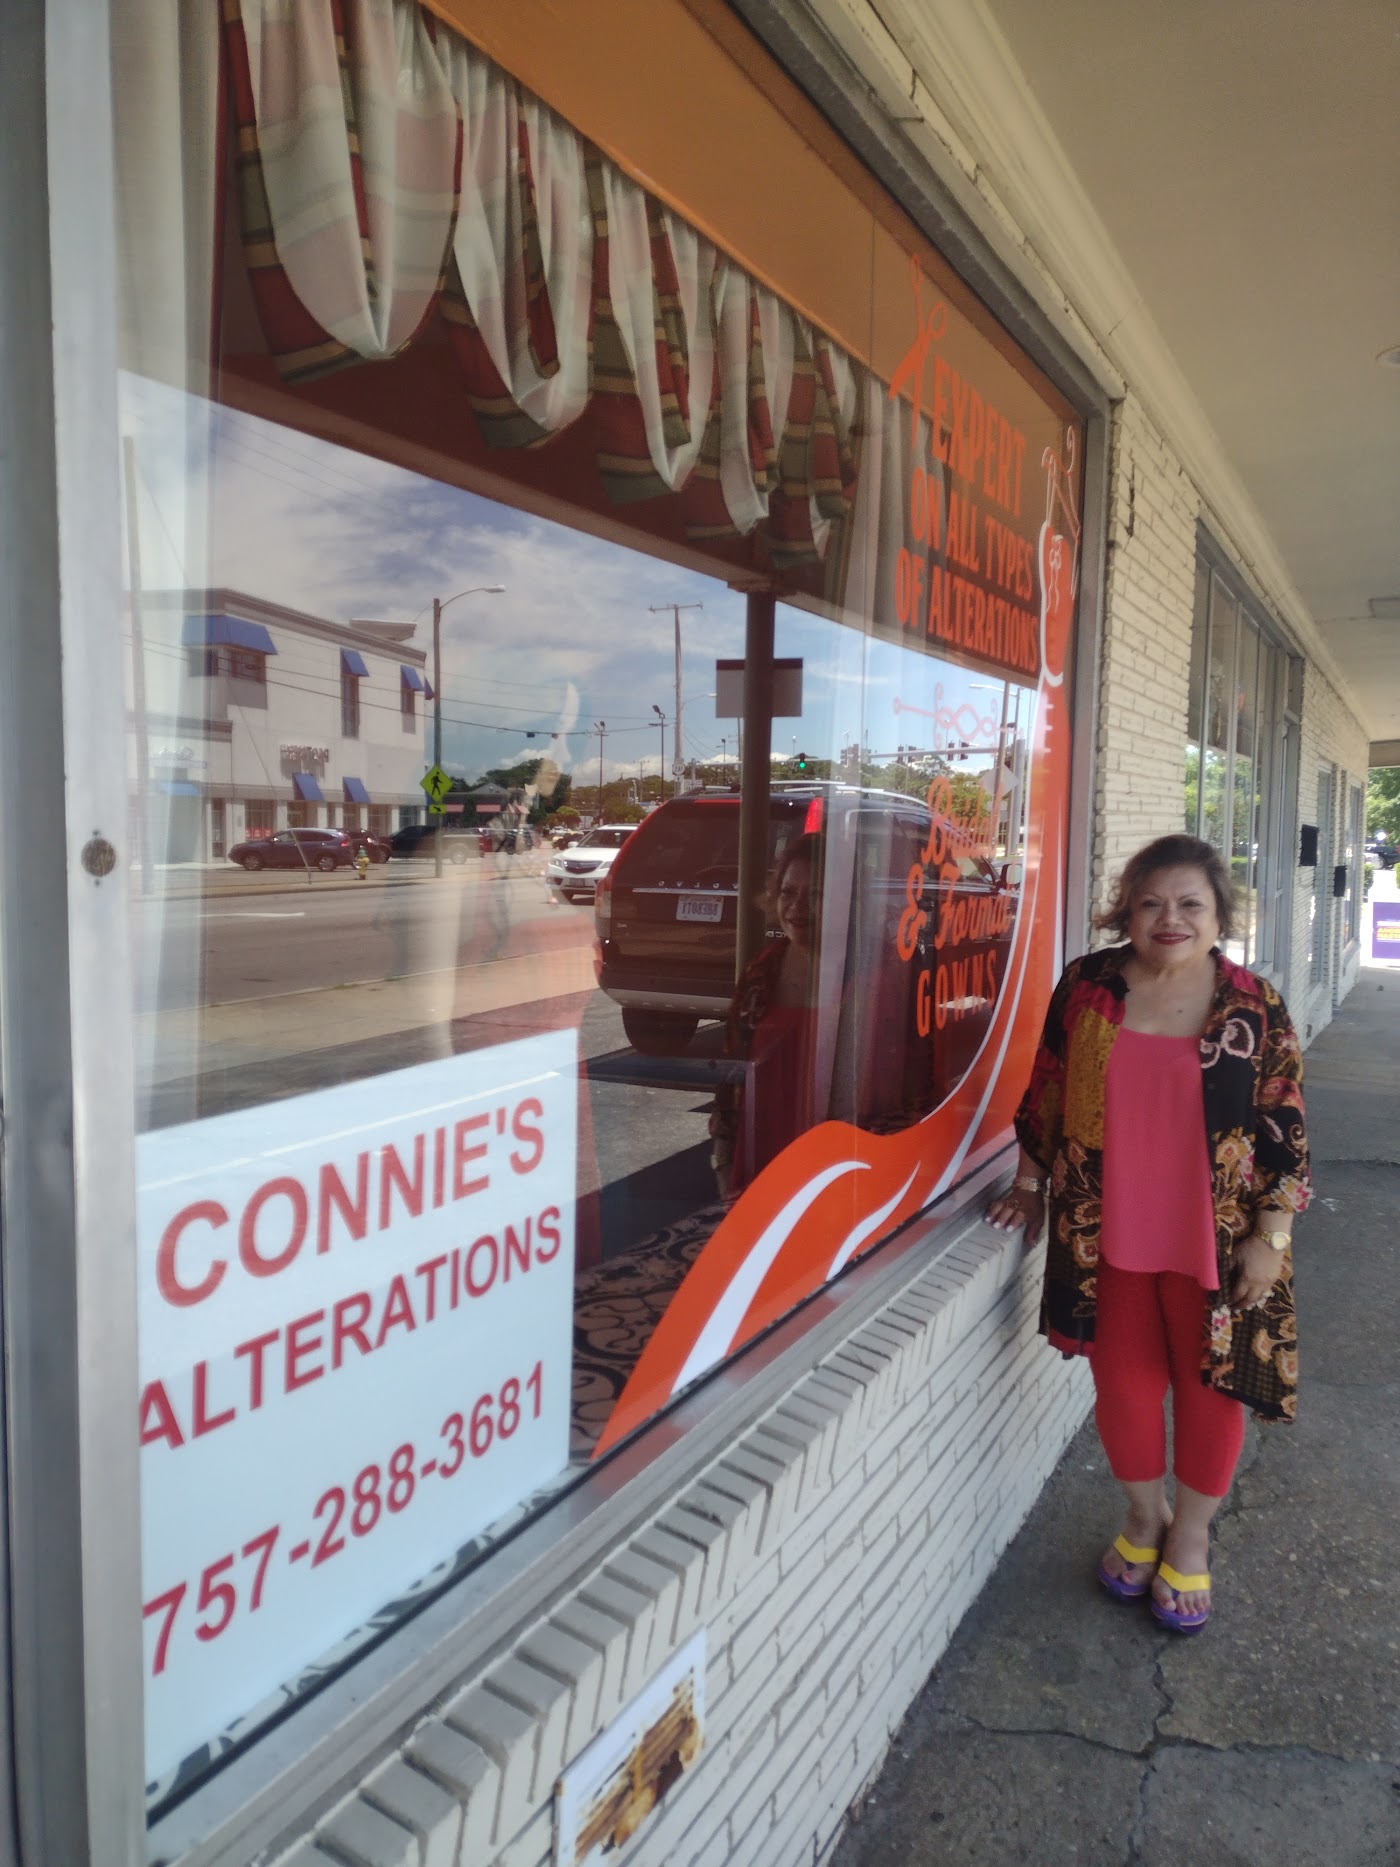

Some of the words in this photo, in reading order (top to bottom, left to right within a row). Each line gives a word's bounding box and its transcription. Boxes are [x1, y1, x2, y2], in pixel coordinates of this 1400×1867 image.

[931, 353, 1026, 519] EXPERT
[911, 466, 942, 551] ON
[945, 489, 980, 574] ALL
[984, 513, 1034, 602] TYPES
[895, 547, 925, 629] OF
[928, 565, 1040, 673] ALTERATIONS
[921, 775, 1004, 865] Bridal
[897, 864, 926, 961] &
[934, 858, 1016, 951] Formal
[916, 949, 998, 1038] GOWNS
[155, 1096, 546, 1309] CONNIE'S
[139, 1205, 562, 1450] ALTERATIONS
[142, 1359, 545, 1677] 757-288-3681
